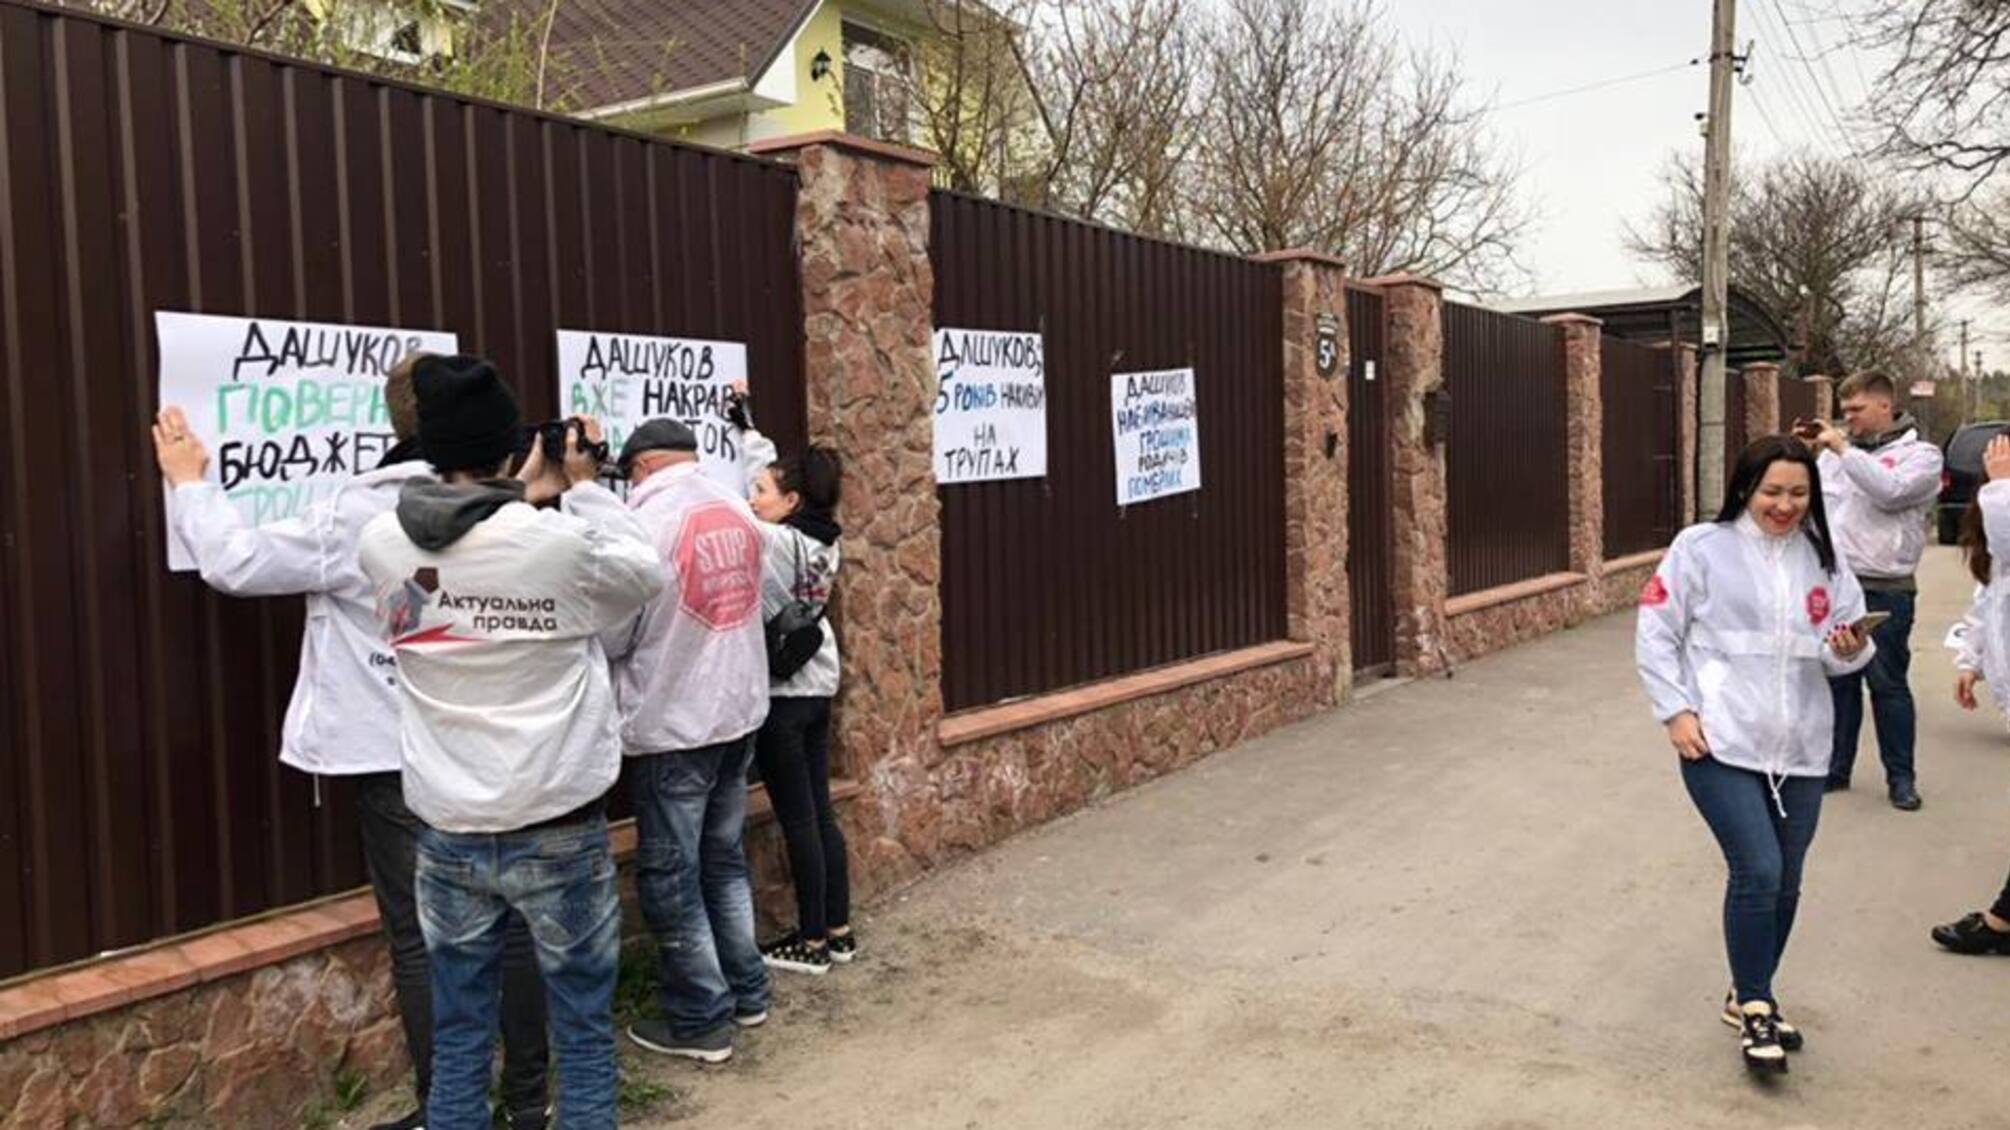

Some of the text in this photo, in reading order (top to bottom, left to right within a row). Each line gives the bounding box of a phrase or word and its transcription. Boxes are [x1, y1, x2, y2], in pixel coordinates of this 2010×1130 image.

[580, 335, 714, 380] ДАШУКОВ
[217, 379, 389, 434] ПОВЕРН
[936, 370, 954, 414] 5
[974, 424, 997, 447] НА
[944, 446, 1020, 478] ТРУПАХ
[438, 591, 556, 613] Актуальна
[472, 615, 558, 633] правда
